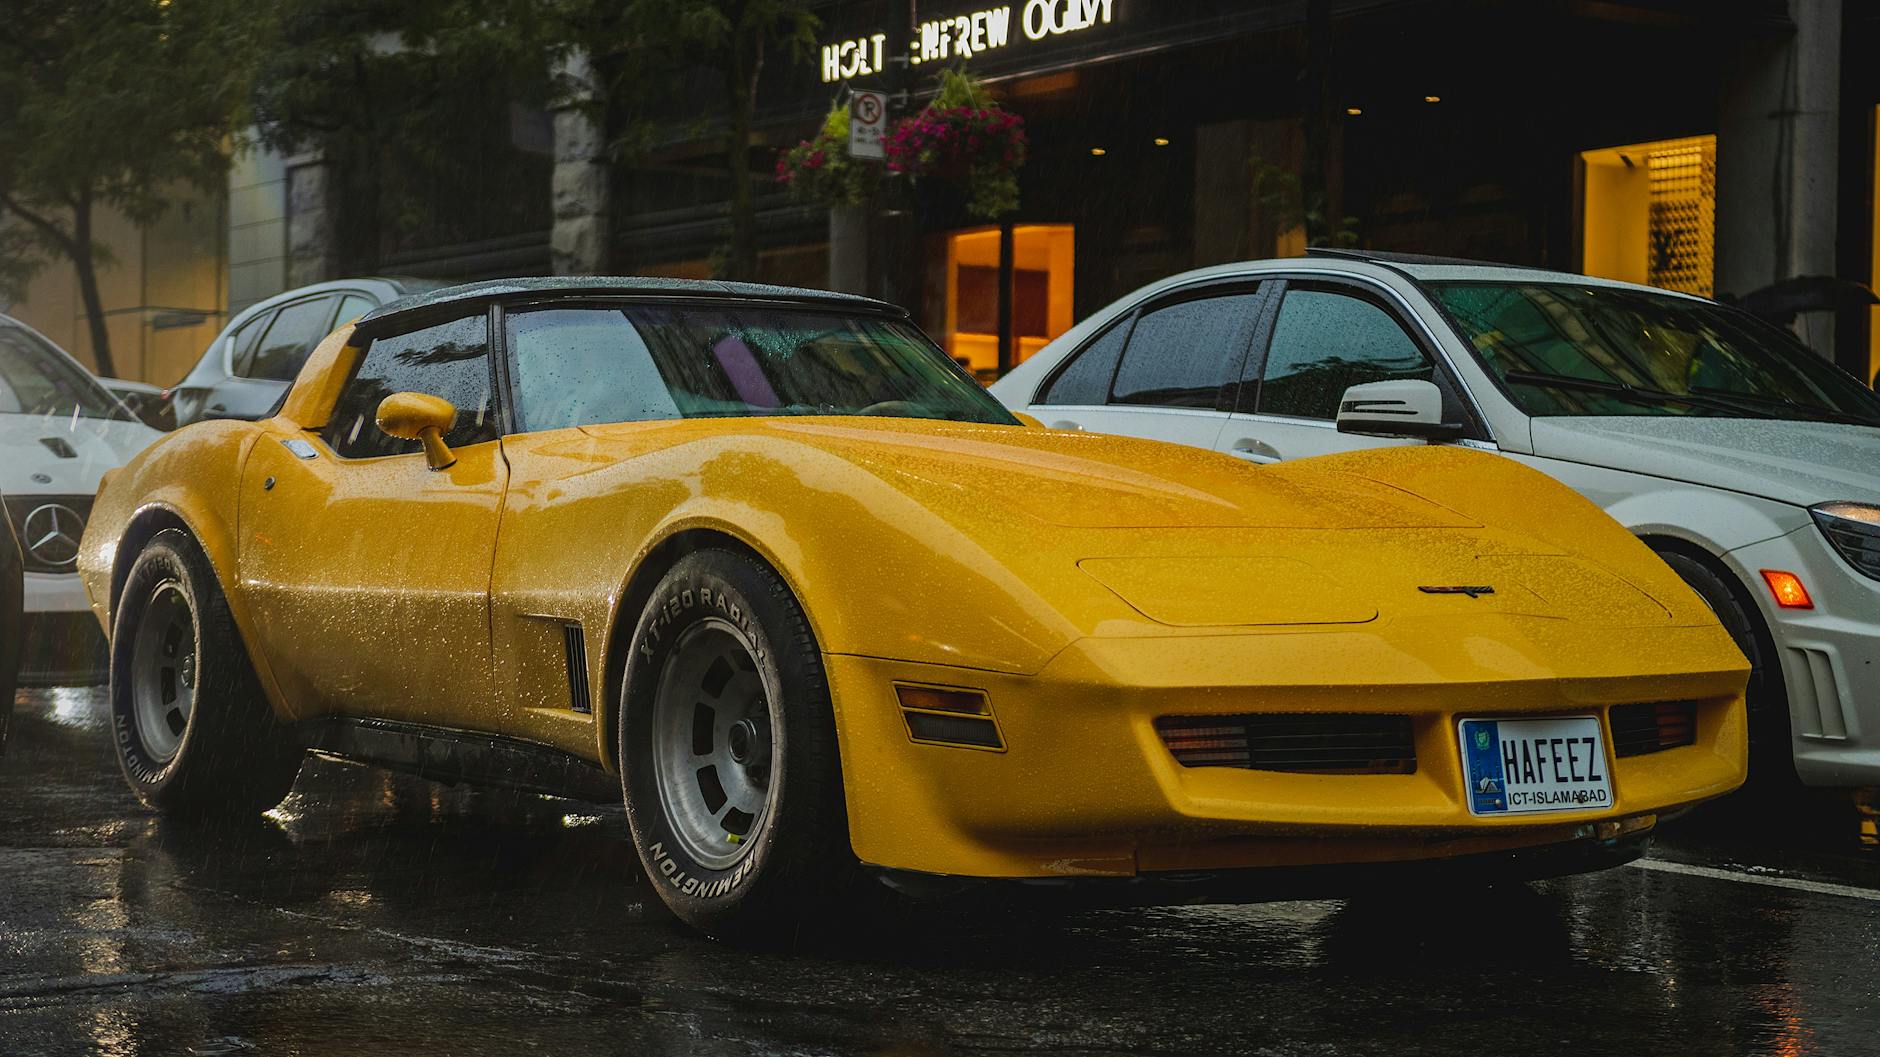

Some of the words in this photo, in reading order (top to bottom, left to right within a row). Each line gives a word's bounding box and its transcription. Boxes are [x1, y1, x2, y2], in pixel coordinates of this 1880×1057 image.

[822, 33, 886, 83] HOLT
[1022, 0, 1112, 40] OGILVY
[640, 588, 694, 664] XT-120
[700, 587, 766, 669] RADIAL
[1502, 737, 1602, 785] HAFEEZ
[1508, 789, 1607, 805] ICT-ISLAMABAD
[649, 841, 756, 898] REMINGTON
